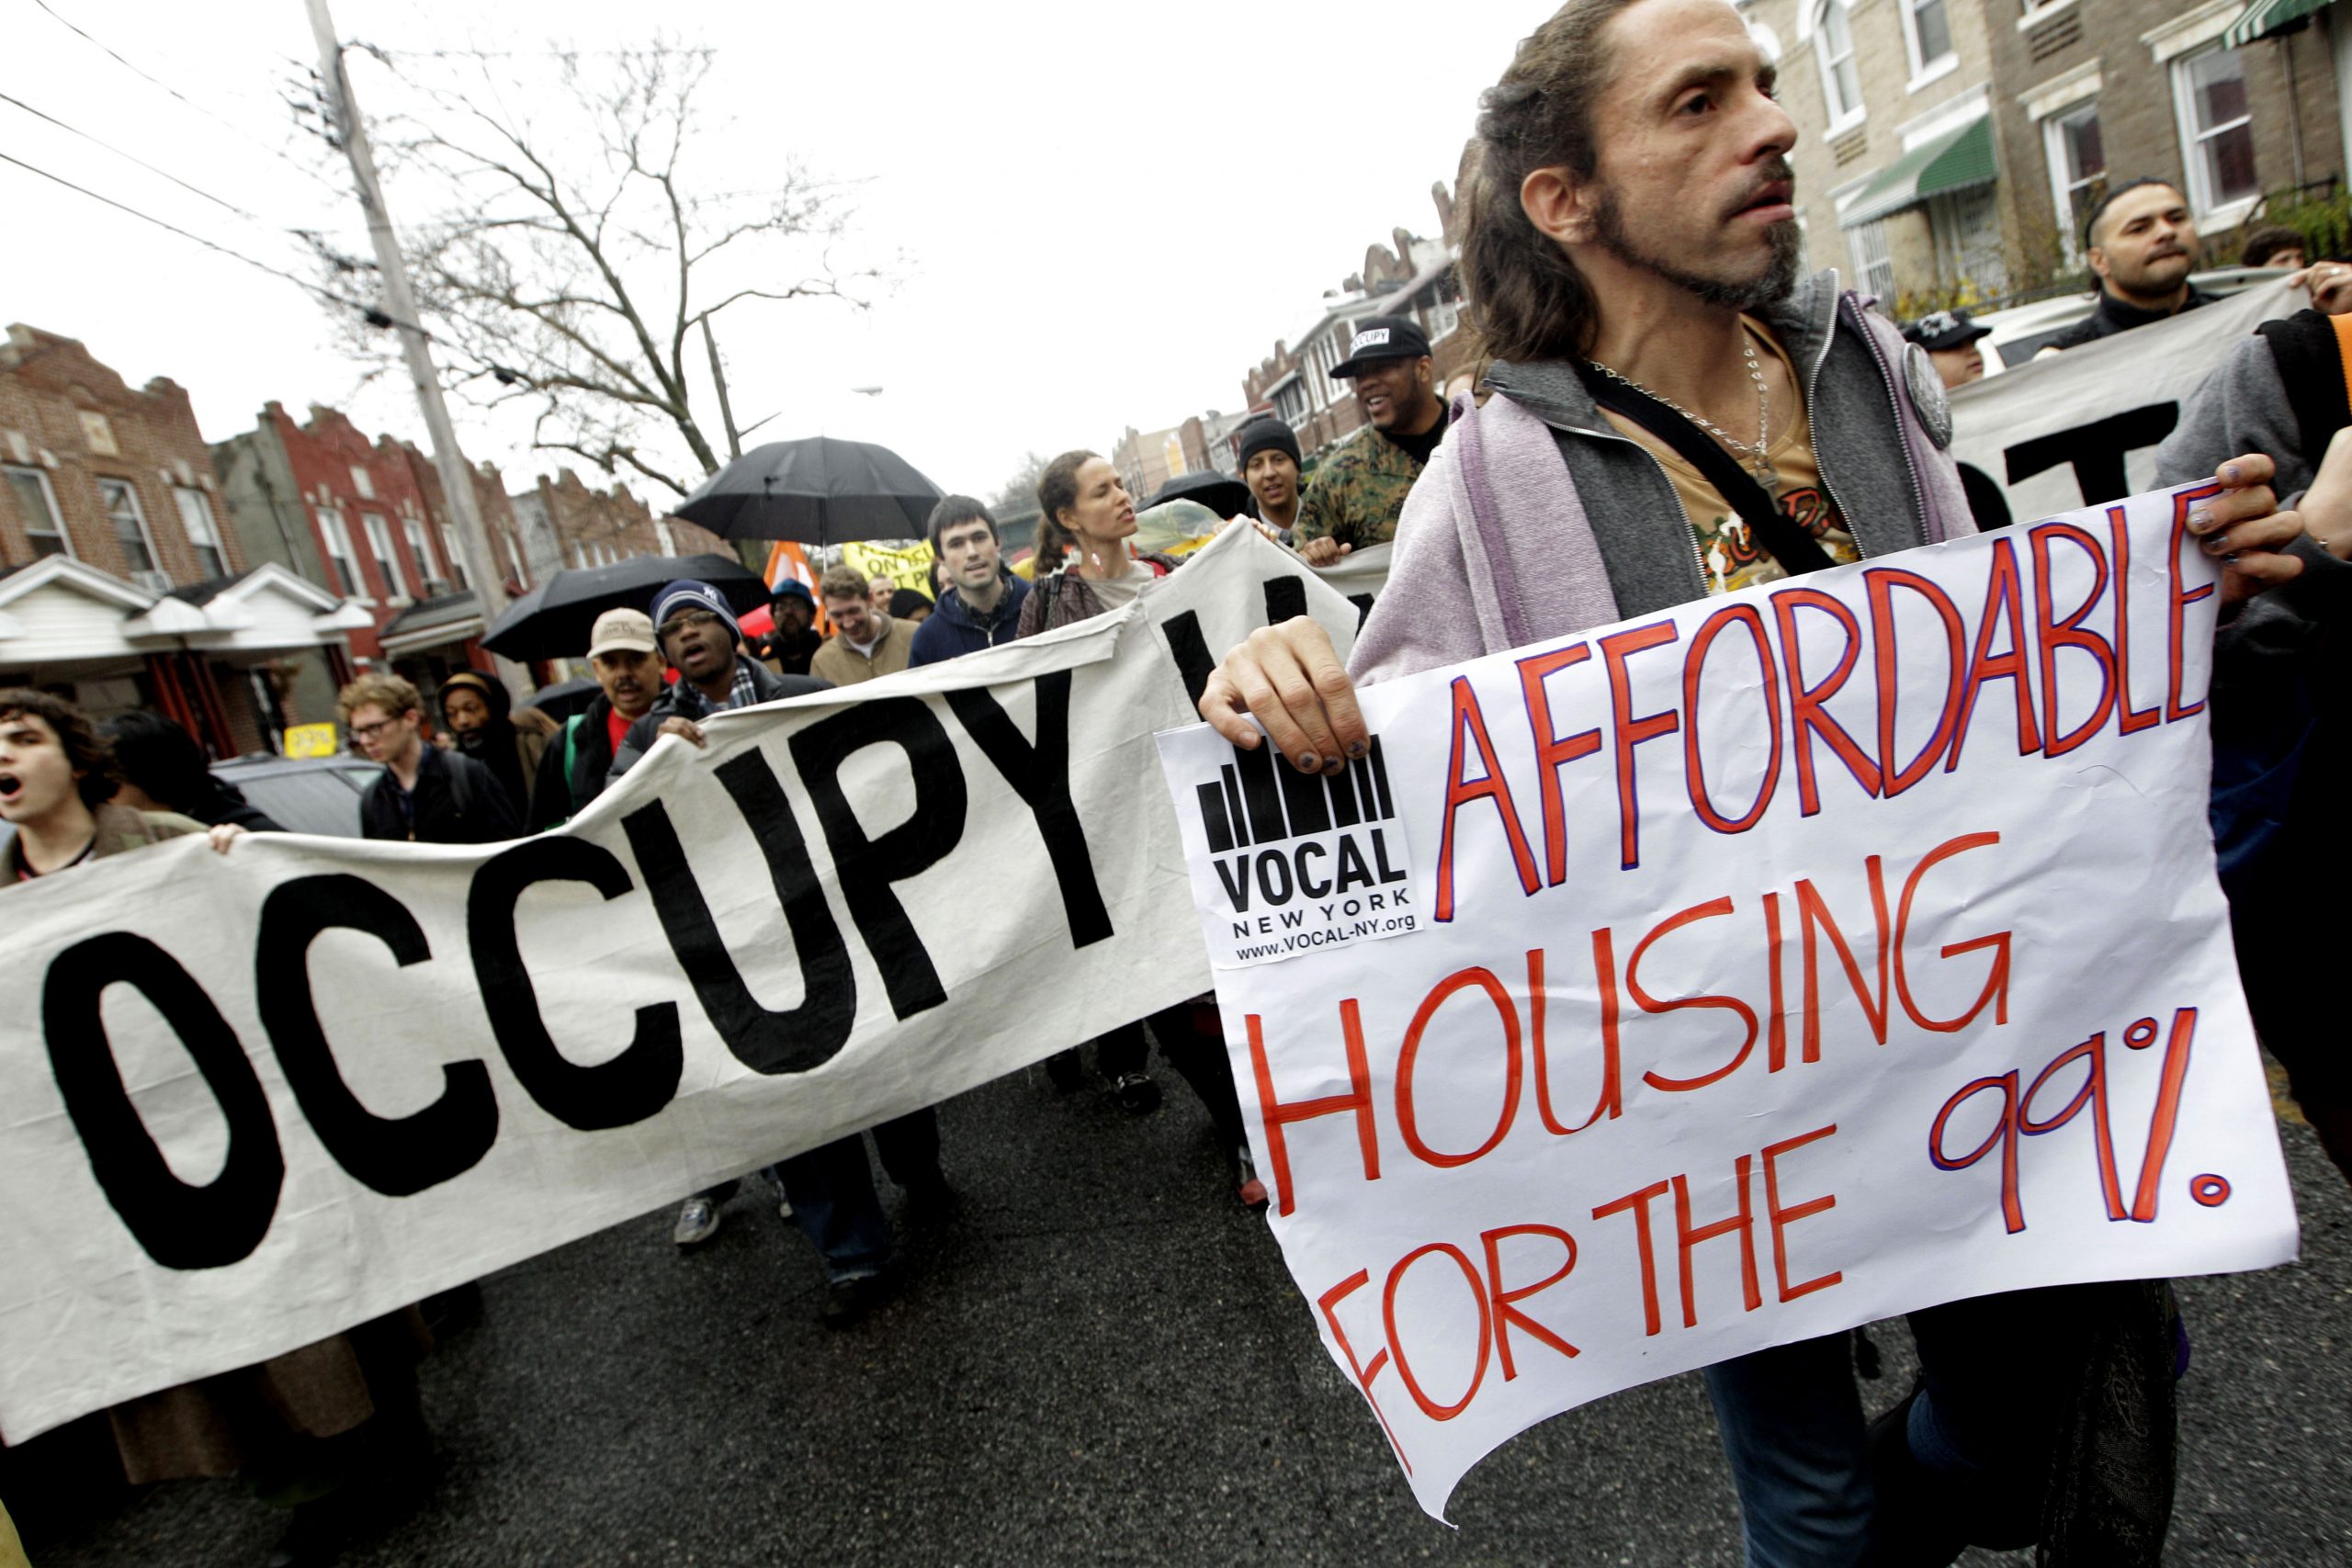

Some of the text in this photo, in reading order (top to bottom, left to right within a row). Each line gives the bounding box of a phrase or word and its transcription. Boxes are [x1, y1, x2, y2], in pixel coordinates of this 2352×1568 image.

[1212, 828, 1408, 913] VOCAL
[1433, 480, 2223, 924] AFFORDABLE
[40, 667, 1115, 1272] OCCUPY
[1232, 888, 1411, 939] NEW YORK
[1236, 914, 1416, 960] www.VOCAL-NY.org
[1245, 830, 2012, 1218] HOUSING
[1317, 1224, 1582, 1478] FOR
[1591, 1123, 1844, 1337] THE
